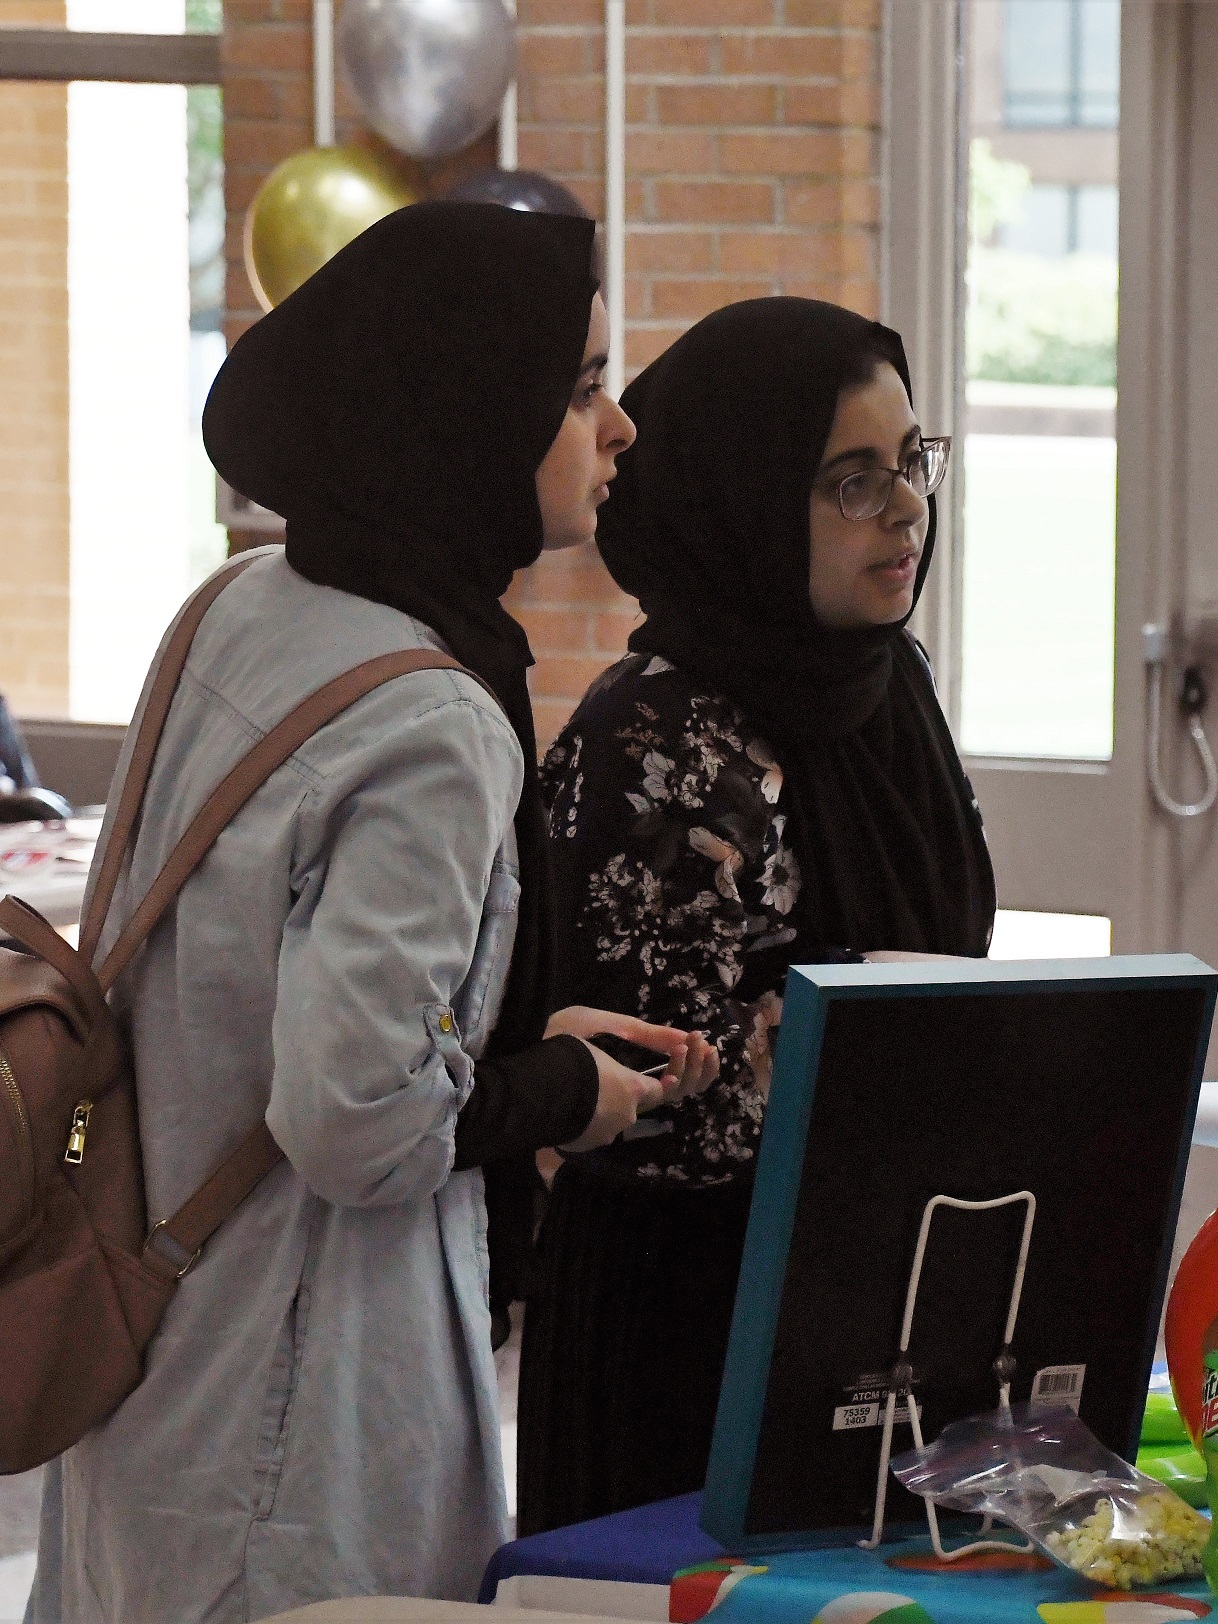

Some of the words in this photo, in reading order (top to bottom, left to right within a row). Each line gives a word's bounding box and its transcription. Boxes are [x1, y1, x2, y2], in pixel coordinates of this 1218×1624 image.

[852, 1390, 880, 1402] ATCM
[843, 1406, 871, 1418] 75359
[845, 1415, 867, 1426] 1403
